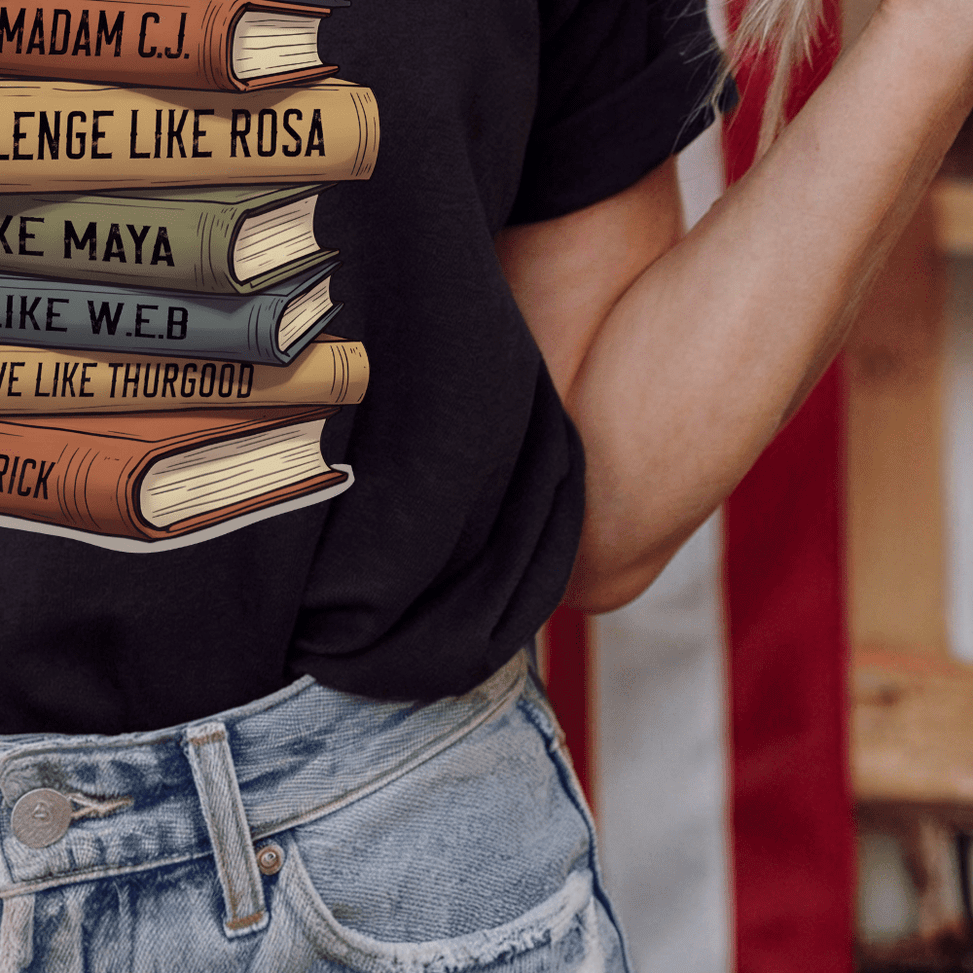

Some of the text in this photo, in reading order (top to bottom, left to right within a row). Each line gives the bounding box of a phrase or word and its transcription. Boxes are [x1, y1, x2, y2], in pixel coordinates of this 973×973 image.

[137, 12, 190, 59] C.J.
[130, 108, 213, 160] LIKE
[229, 108, 326, 157] ROSA
[63, 220, 175, 267] MAYA
[87, 300, 188, 340] W.E.B
[35, 363, 95, 398] LIKE
[107, 363, 254, 399] THURGOOD
